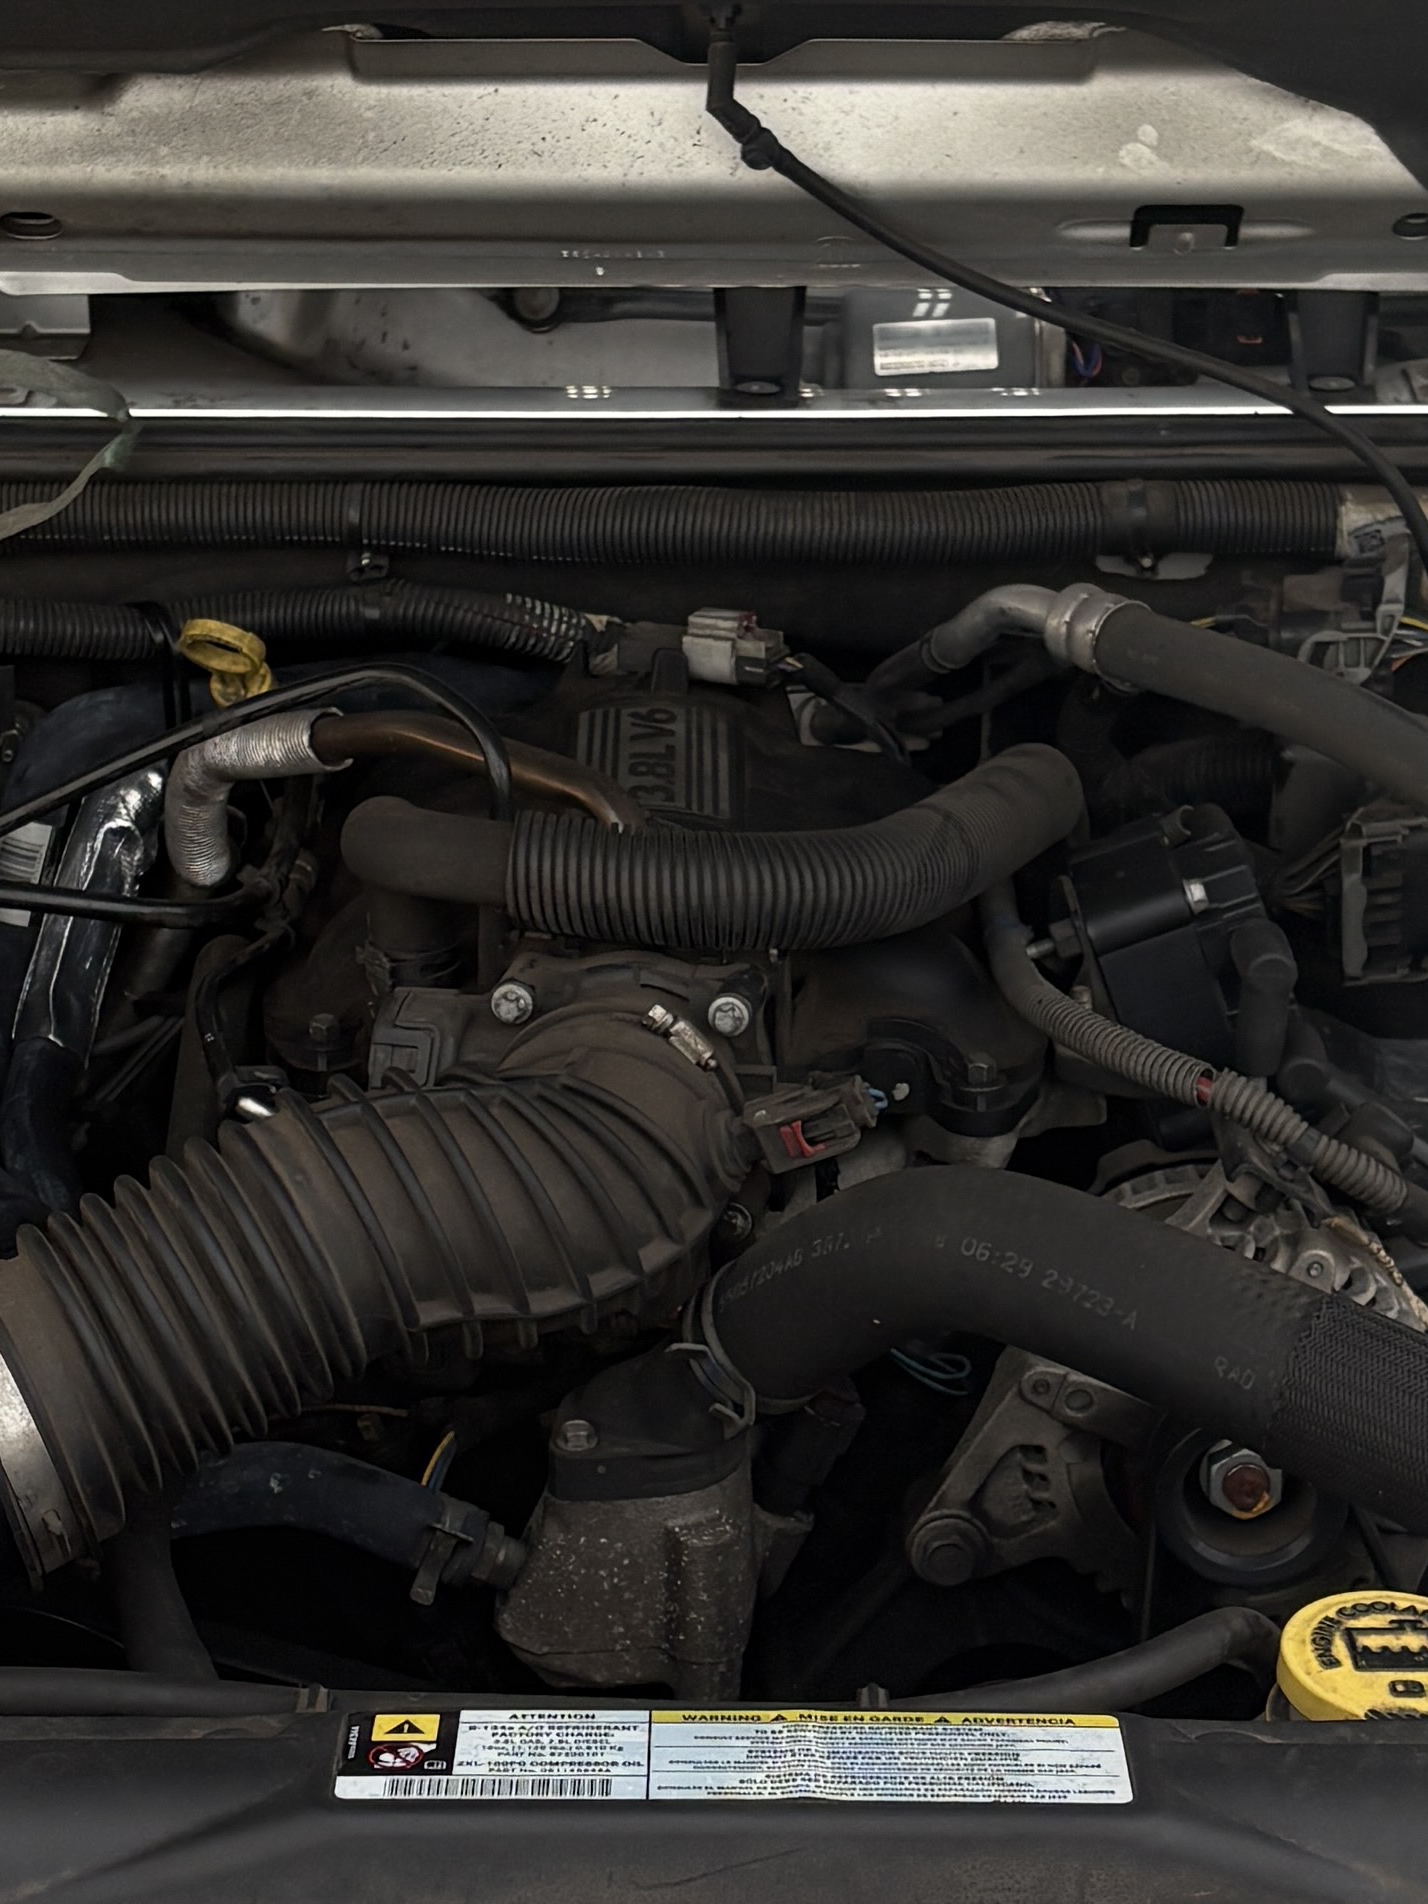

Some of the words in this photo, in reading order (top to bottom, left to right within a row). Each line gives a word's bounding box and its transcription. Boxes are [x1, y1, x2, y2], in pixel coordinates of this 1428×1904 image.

[630, 706, 677, 743] V6
[960, 1235, 1035, 1279] 06:29
[1310, 1615, 1343, 1671] ENGINE
[681, 1714, 762, 1722] WARNING
[798, 1713, 840, 1723] MISE
[961, 1716, 1076, 1726] ADVERTENCIA
